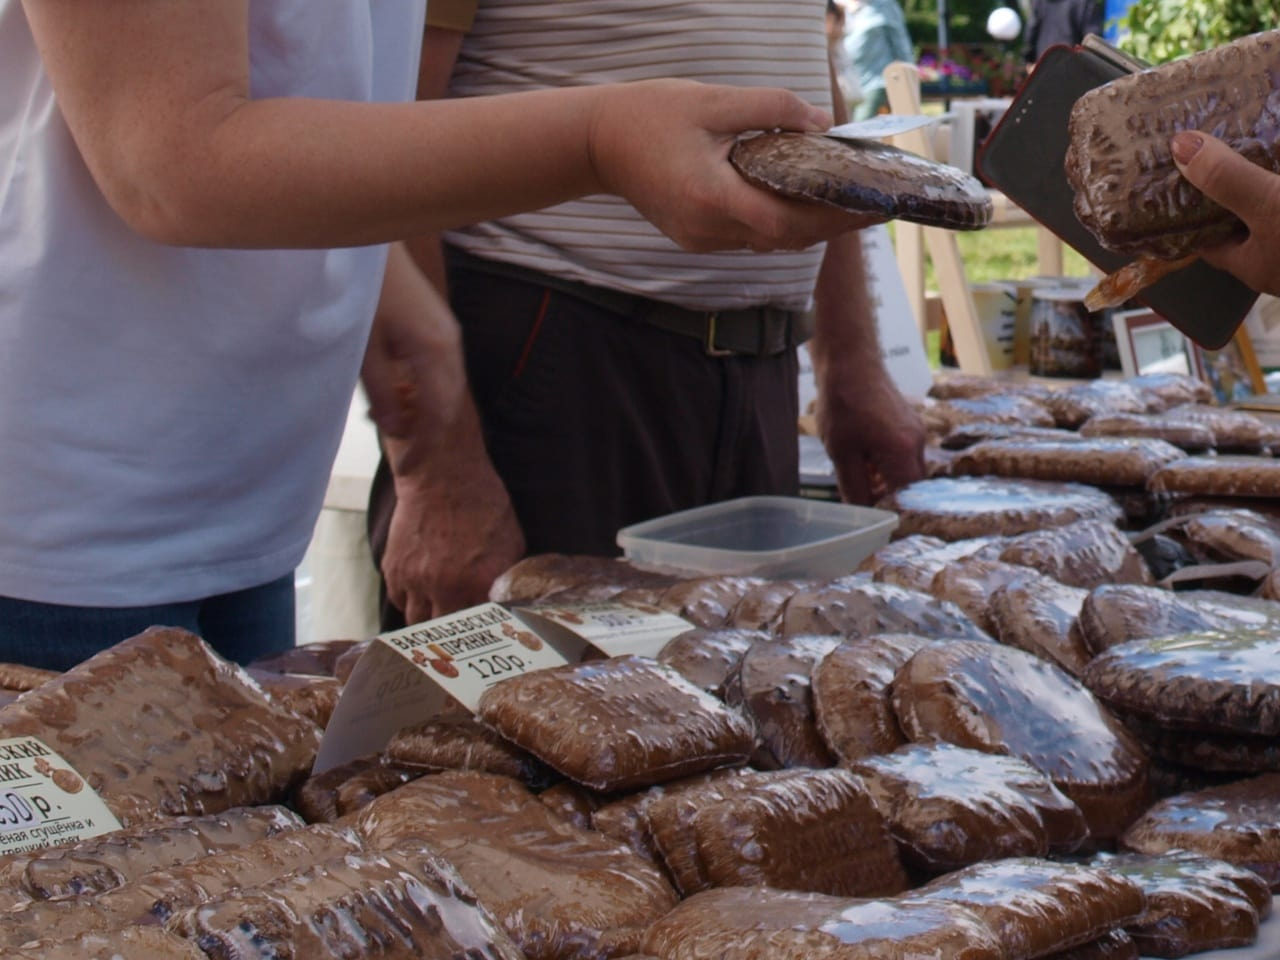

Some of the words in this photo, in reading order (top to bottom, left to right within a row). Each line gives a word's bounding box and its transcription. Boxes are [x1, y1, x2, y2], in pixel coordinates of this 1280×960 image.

[391, 607, 512, 651] ВАСИЛЬЕВСКИЙ
[439, 629, 504, 656] ПРЯНИК
[468, 654, 533, 679] 120р.
[30, 820, 85, 839] сгущёнка
[85, 818, 95, 828] и
